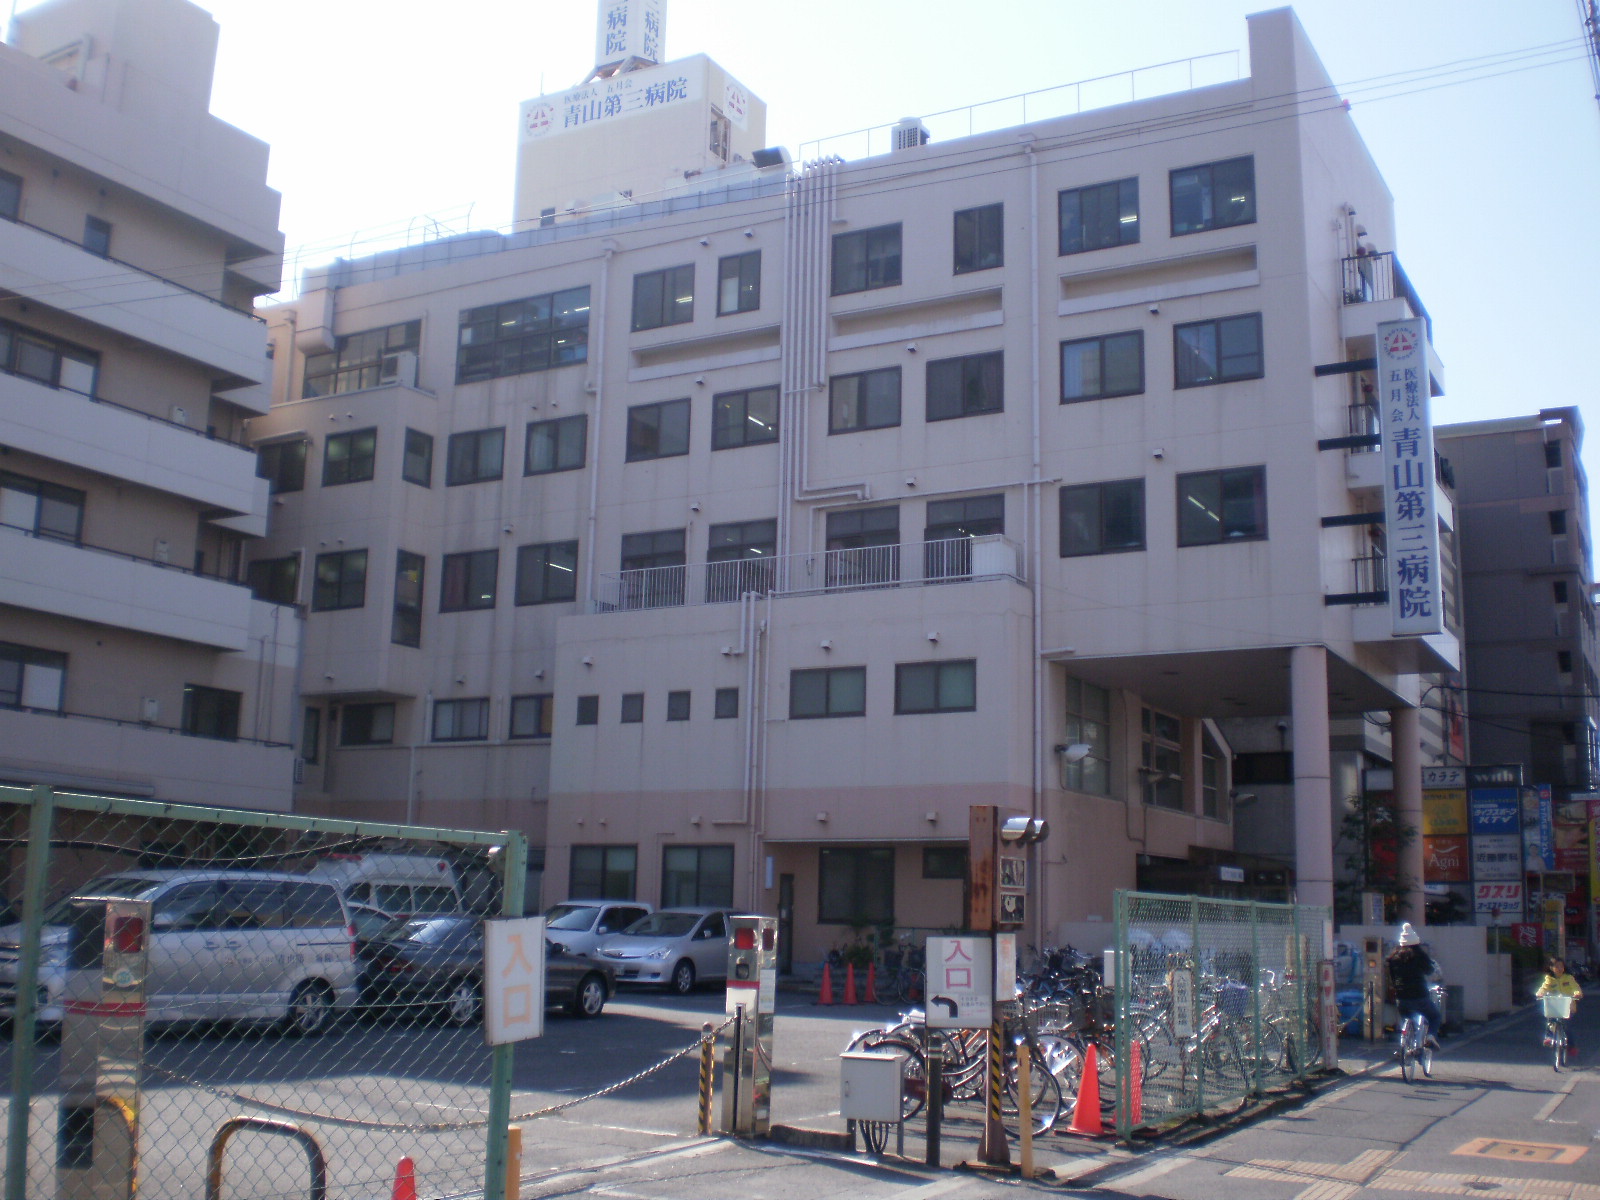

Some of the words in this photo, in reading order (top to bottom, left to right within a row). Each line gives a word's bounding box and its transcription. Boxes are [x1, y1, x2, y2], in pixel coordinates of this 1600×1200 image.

[605, 0, 628, 55] 病院
[564, 77, 688, 128] 青山第三病院
[1391, 427, 1432, 619] 青山第三病院
[1427, 770, 1460, 782] カラテ
[1428, 853, 1460, 870] Agni
[1477, 884, 1521, 899] クスリ
[502, 934, 533, 1028] 入口
[944, 940, 974, 990] 入口
